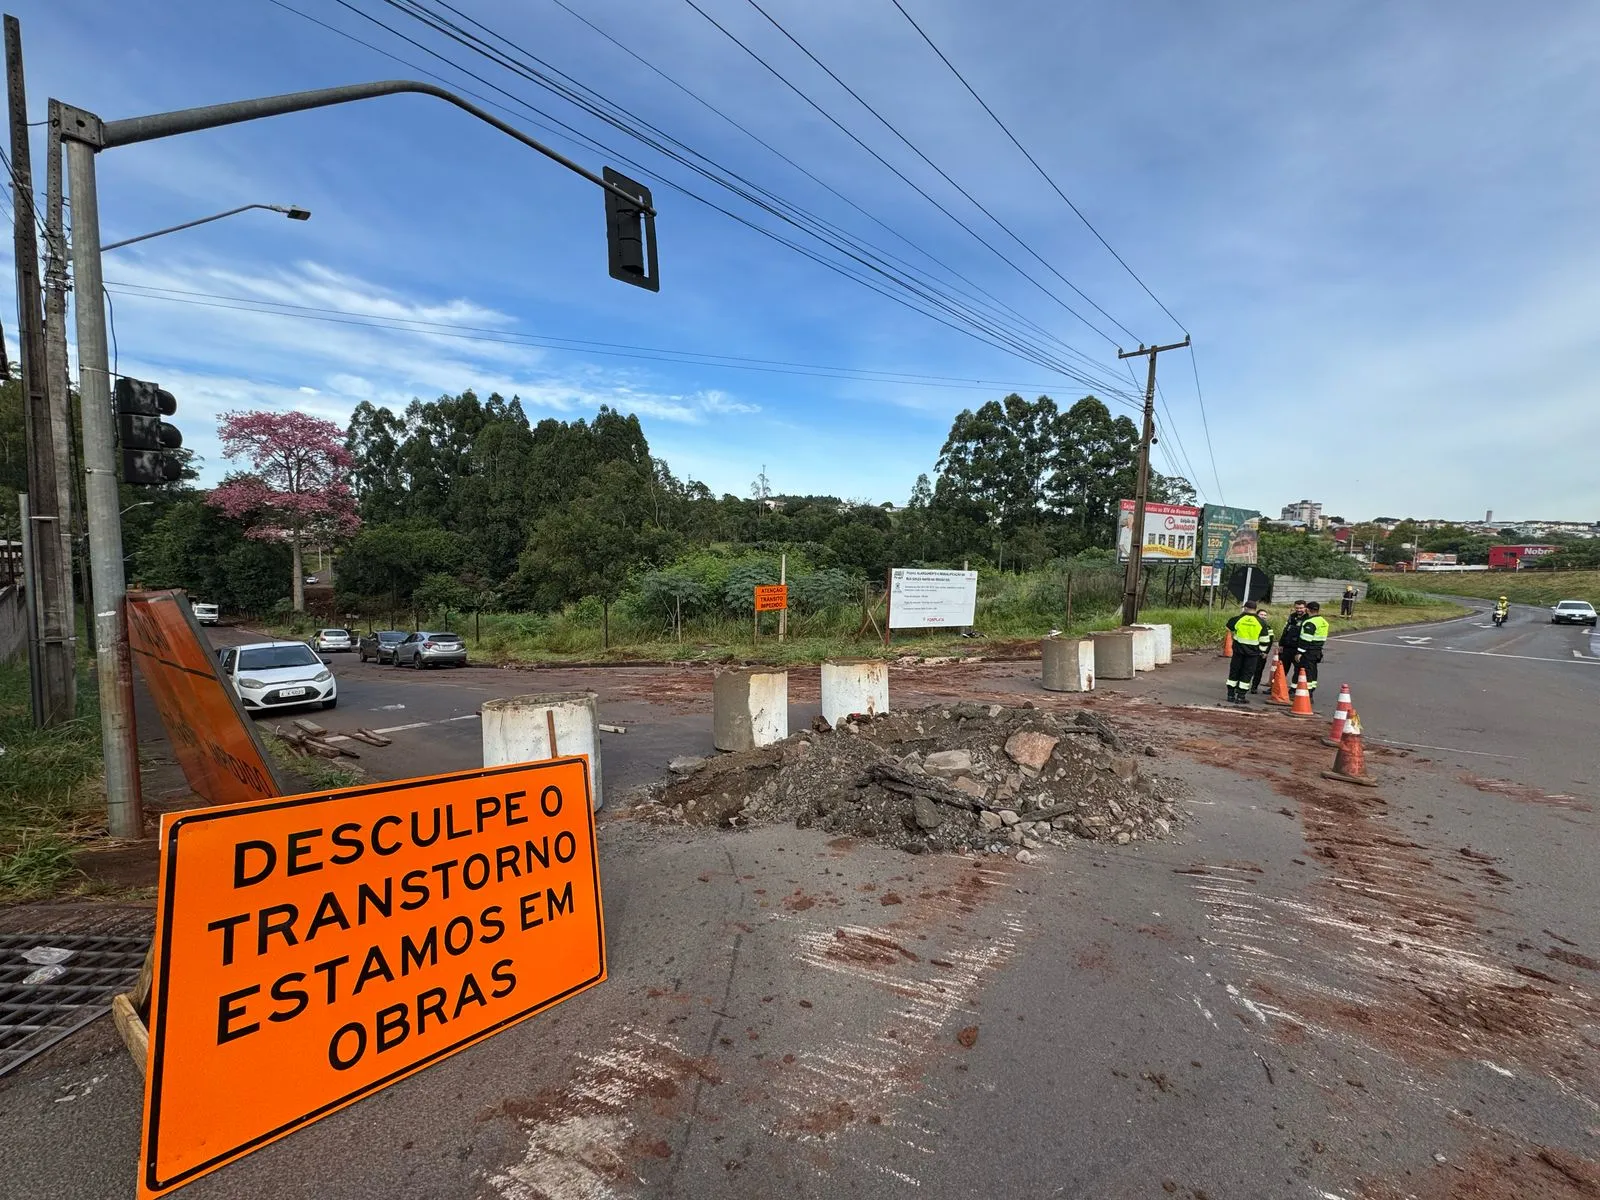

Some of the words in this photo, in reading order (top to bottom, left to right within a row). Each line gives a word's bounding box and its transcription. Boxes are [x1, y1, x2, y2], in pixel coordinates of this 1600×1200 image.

[207, 830, 577, 967] TRANSTORNO
[234, 791, 529, 889] DESCULPE
[540, 785, 563, 817] O
[217, 905, 506, 1045] ESTAMOS
[521, 882, 575, 932] EM
[328, 958, 518, 1071] OBRAS
